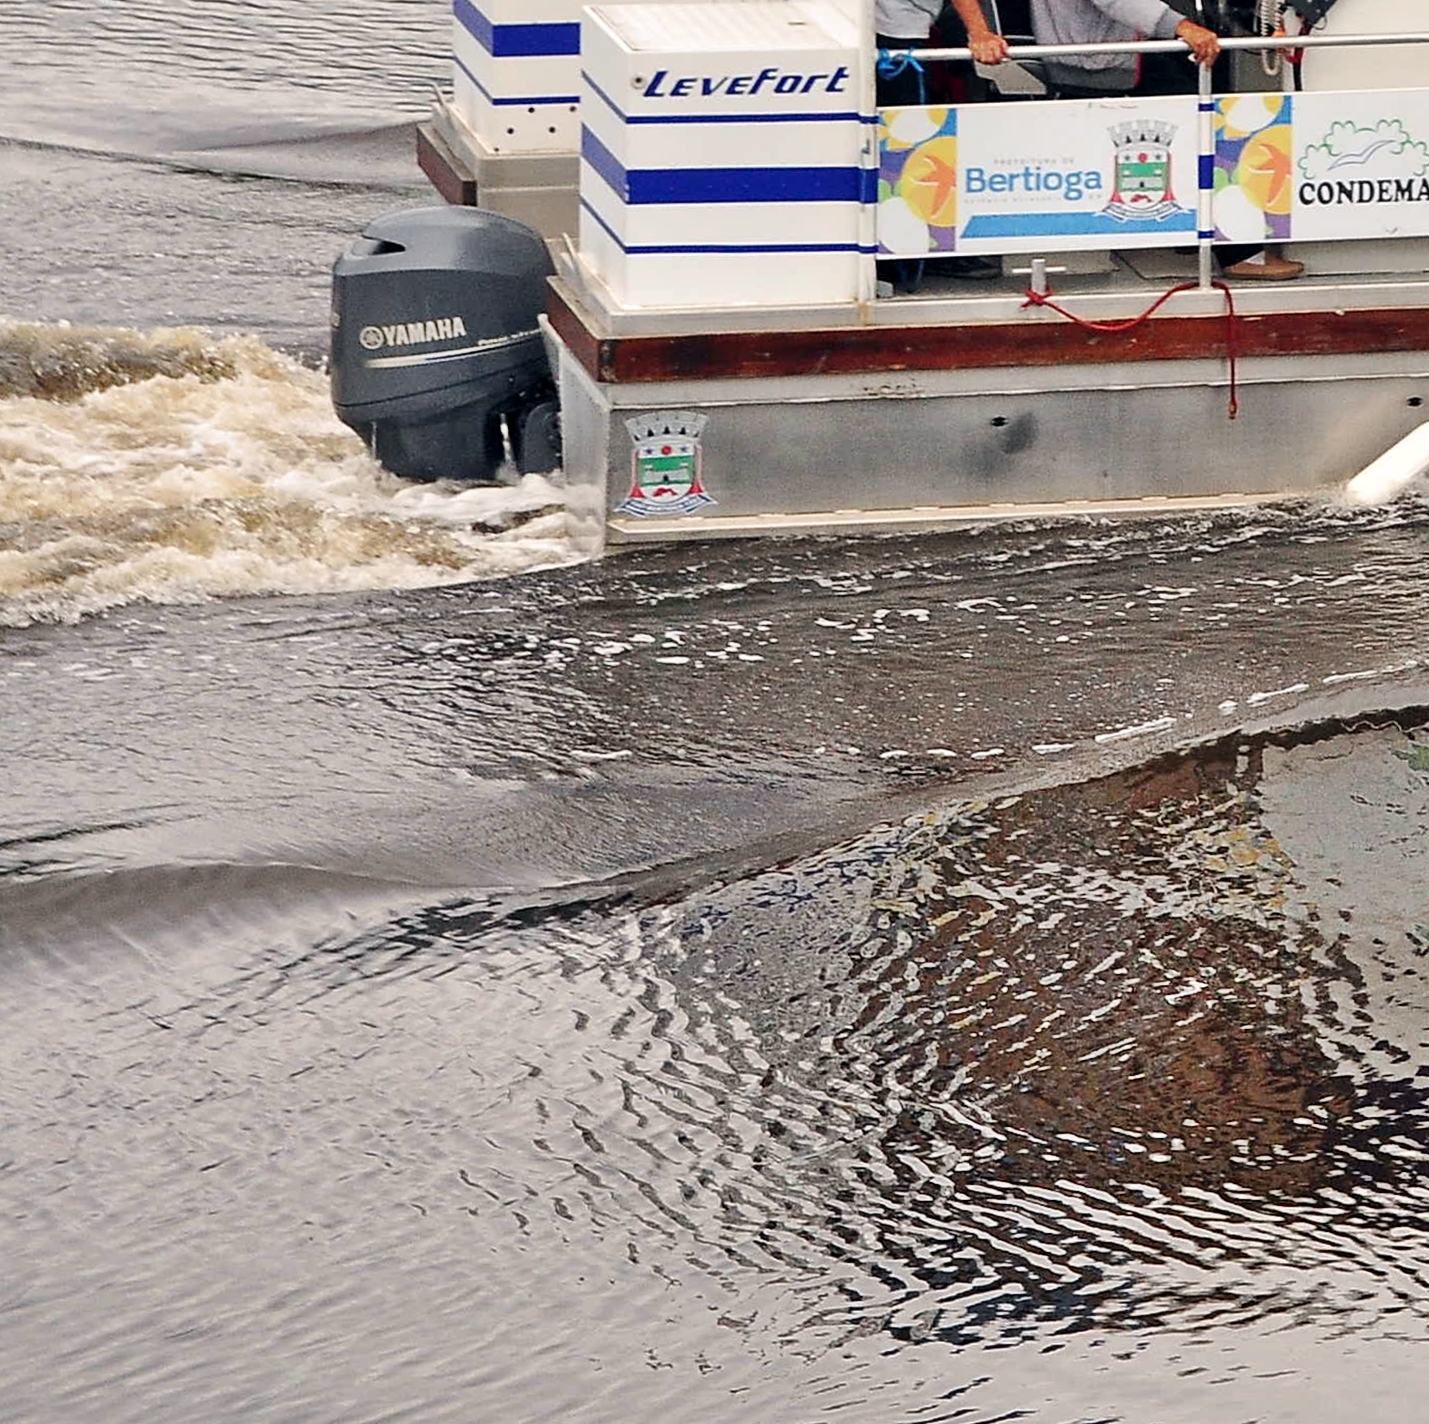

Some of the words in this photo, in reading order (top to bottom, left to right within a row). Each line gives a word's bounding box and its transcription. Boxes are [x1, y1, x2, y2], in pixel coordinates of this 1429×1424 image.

[643, 66, 850, 98] Levefort
[965, 166, 1103, 201] Bertioga
[382, 316, 467, 346] YAMAHA
